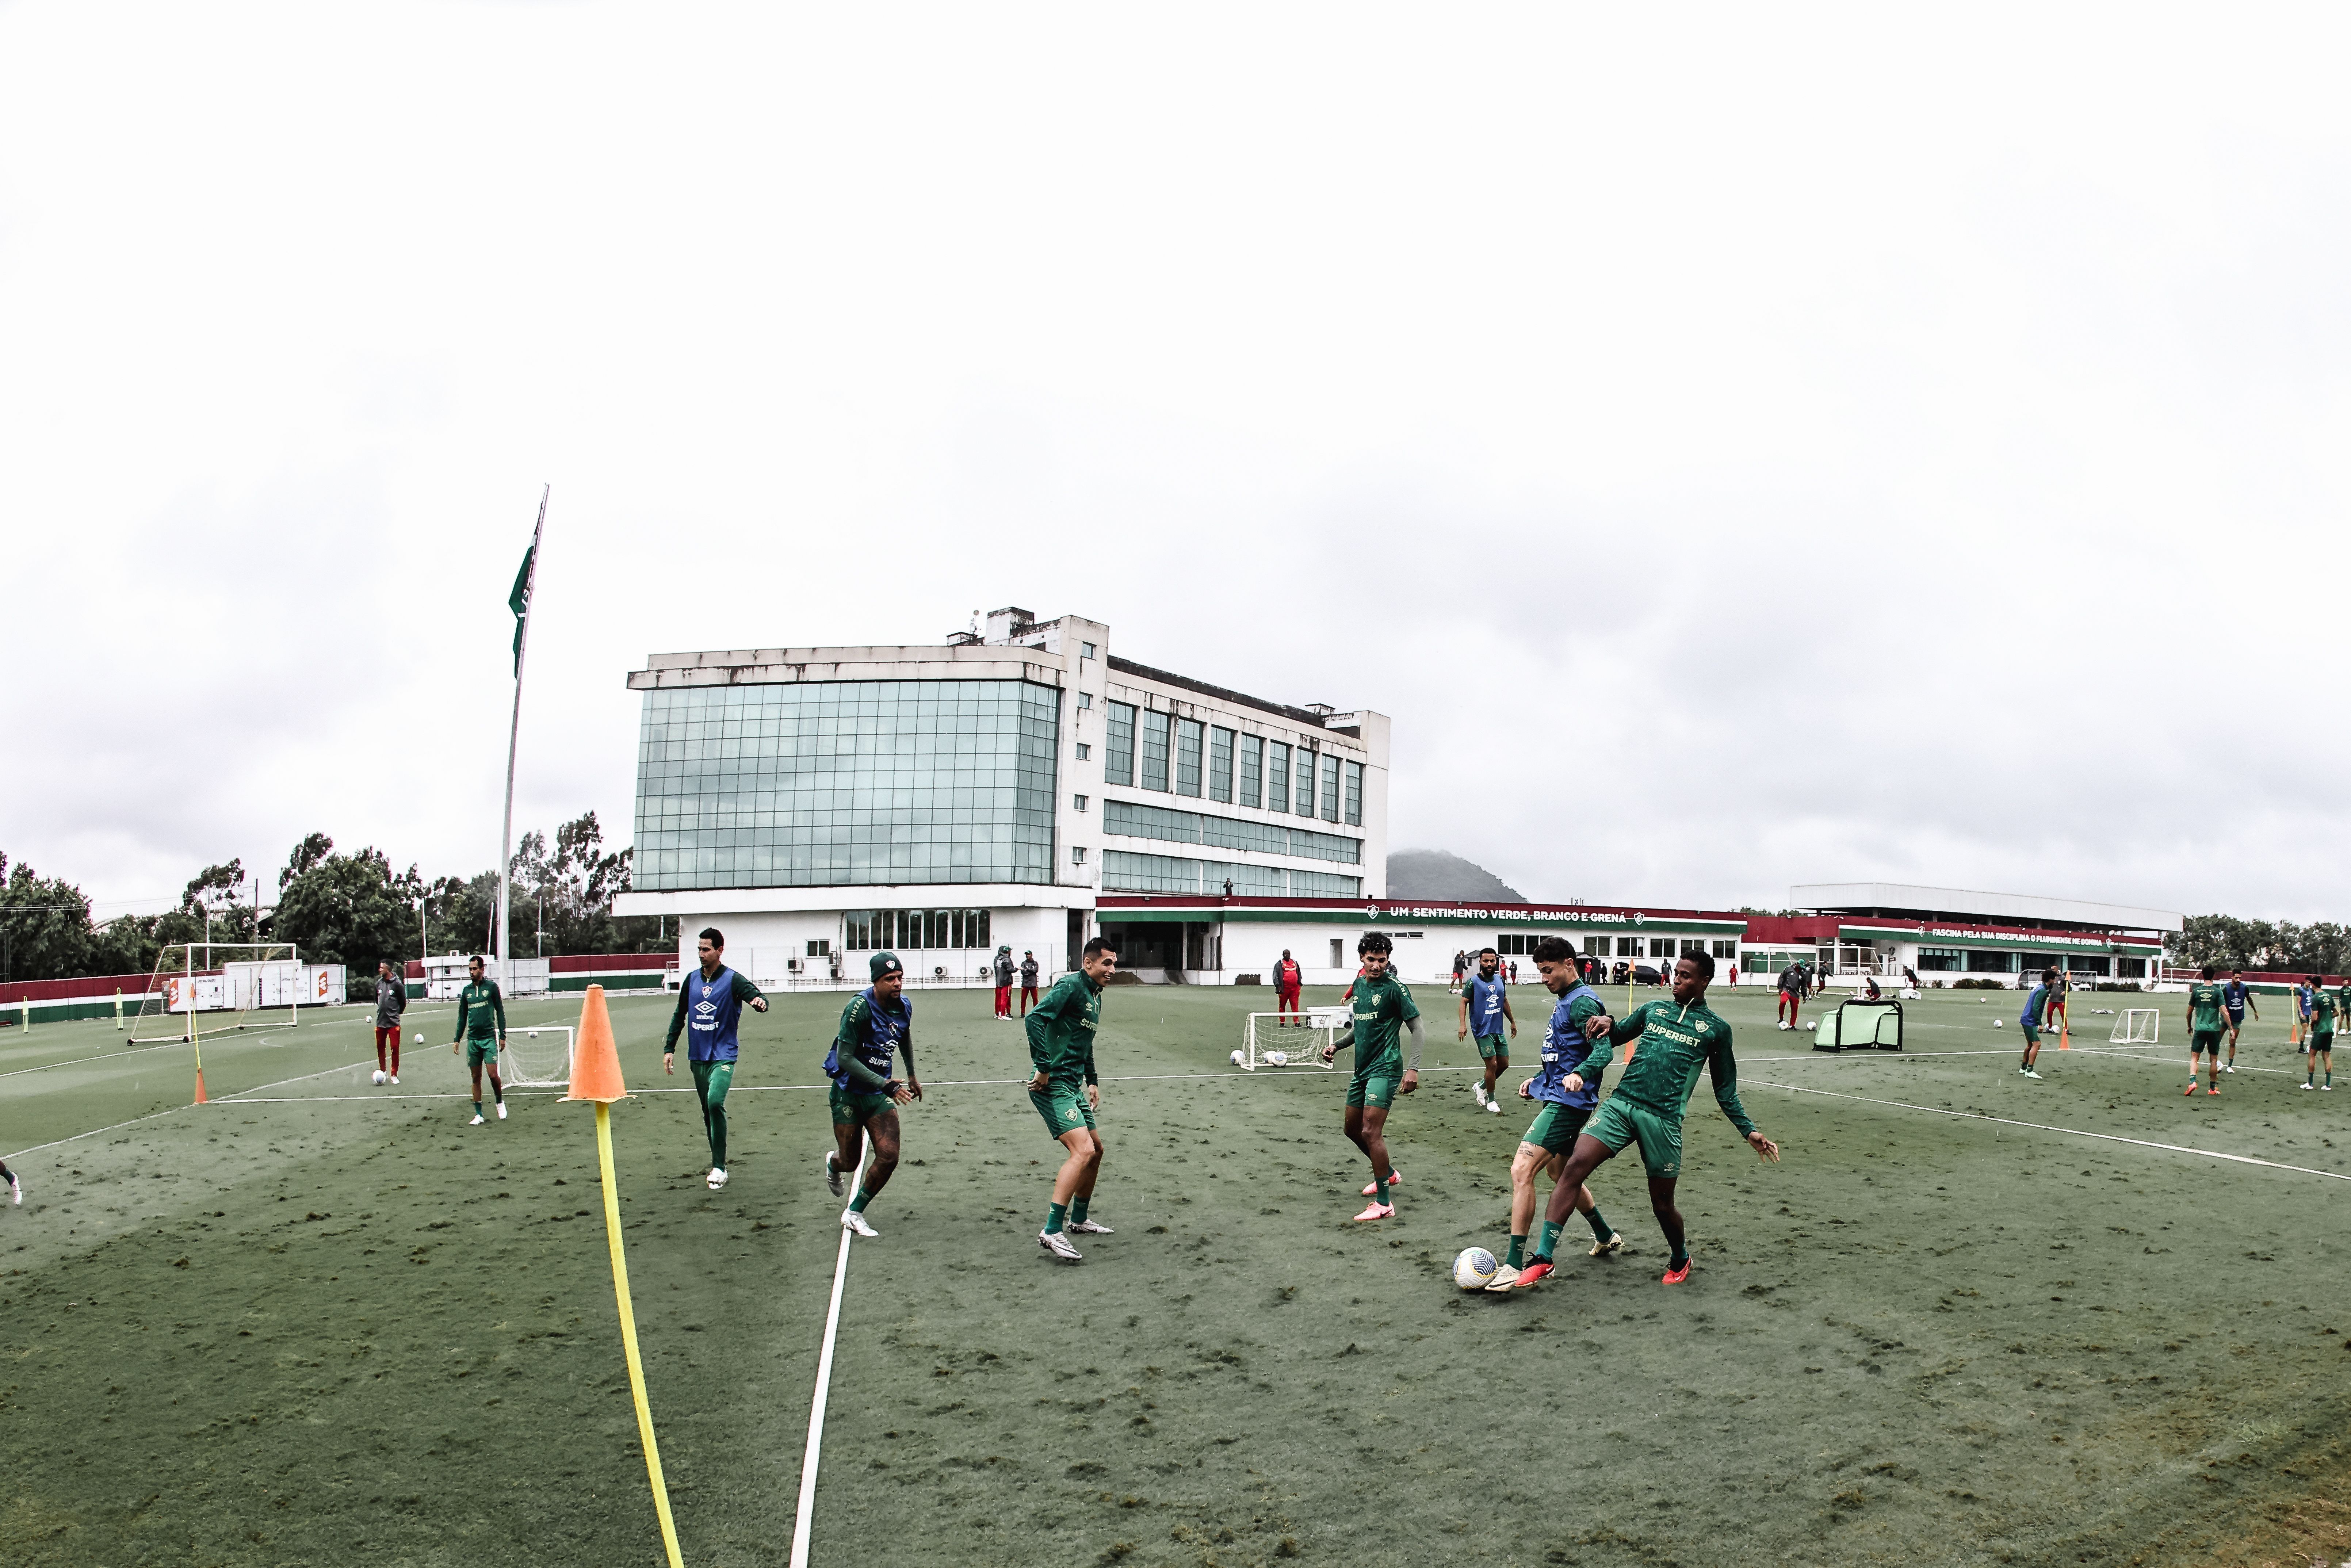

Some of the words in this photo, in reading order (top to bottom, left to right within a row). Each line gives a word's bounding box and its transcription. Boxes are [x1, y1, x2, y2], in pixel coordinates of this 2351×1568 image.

[1390, 907, 1409, 917] UM
[1412, 908, 1488, 919] SENTIMENTO
[1490, 910, 1531, 921] VERDE,
[1533, 911, 1579, 921] BRANCO
[1581, 912, 1588, 922] E
[1590, 911, 1626, 923] GRENÁ
[1932, 928, 1962, 937] FASCINA
[1963, 930, 1980, 939] PELA
[1981, 932, 1995, 940] SUA
[1995, 932, 2030, 941] DISCIPLINA
[2036, 935, 2072, 944] FLUMINENSE
[2072, 937, 2080, 945] ME
[2081, 938, 2103, 946] DOMINA
[1647, 1022, 1700, 1047] SUPERBET
